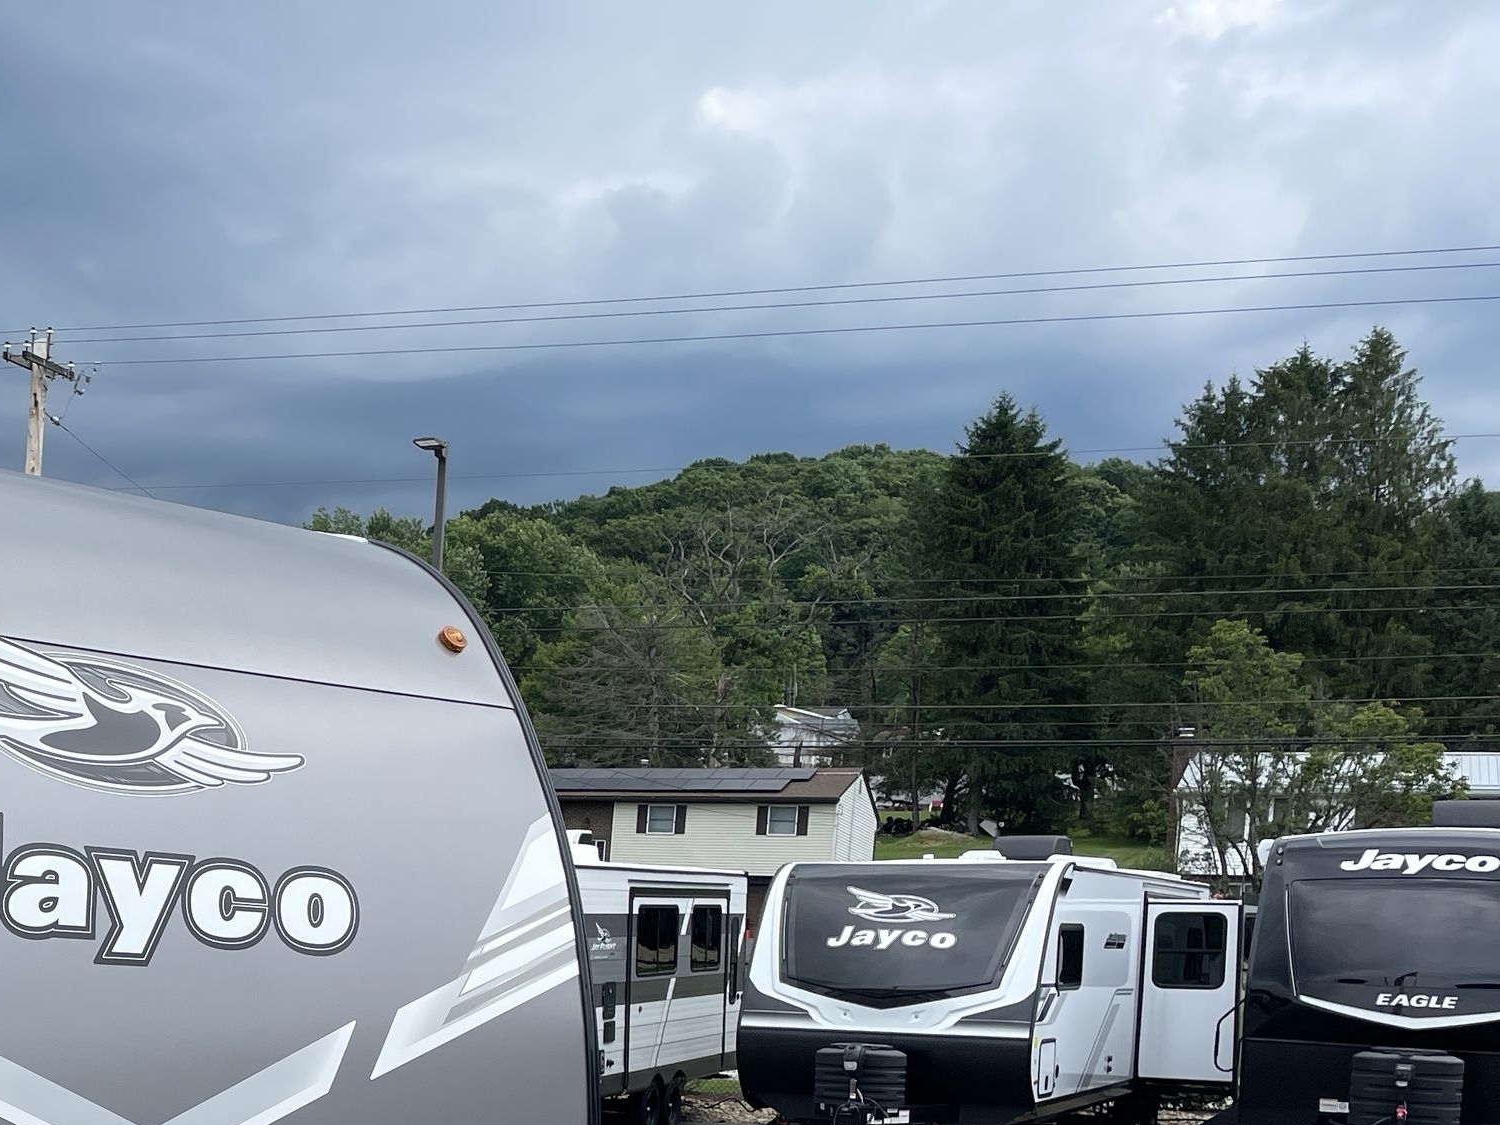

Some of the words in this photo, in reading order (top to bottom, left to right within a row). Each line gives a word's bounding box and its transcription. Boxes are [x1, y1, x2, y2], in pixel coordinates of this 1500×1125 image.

[1339, 849, 1500, 875] Jayco
[826, 925, 957, 950] Jayco
[1376, 993, 1459, 1009] EAGLE
